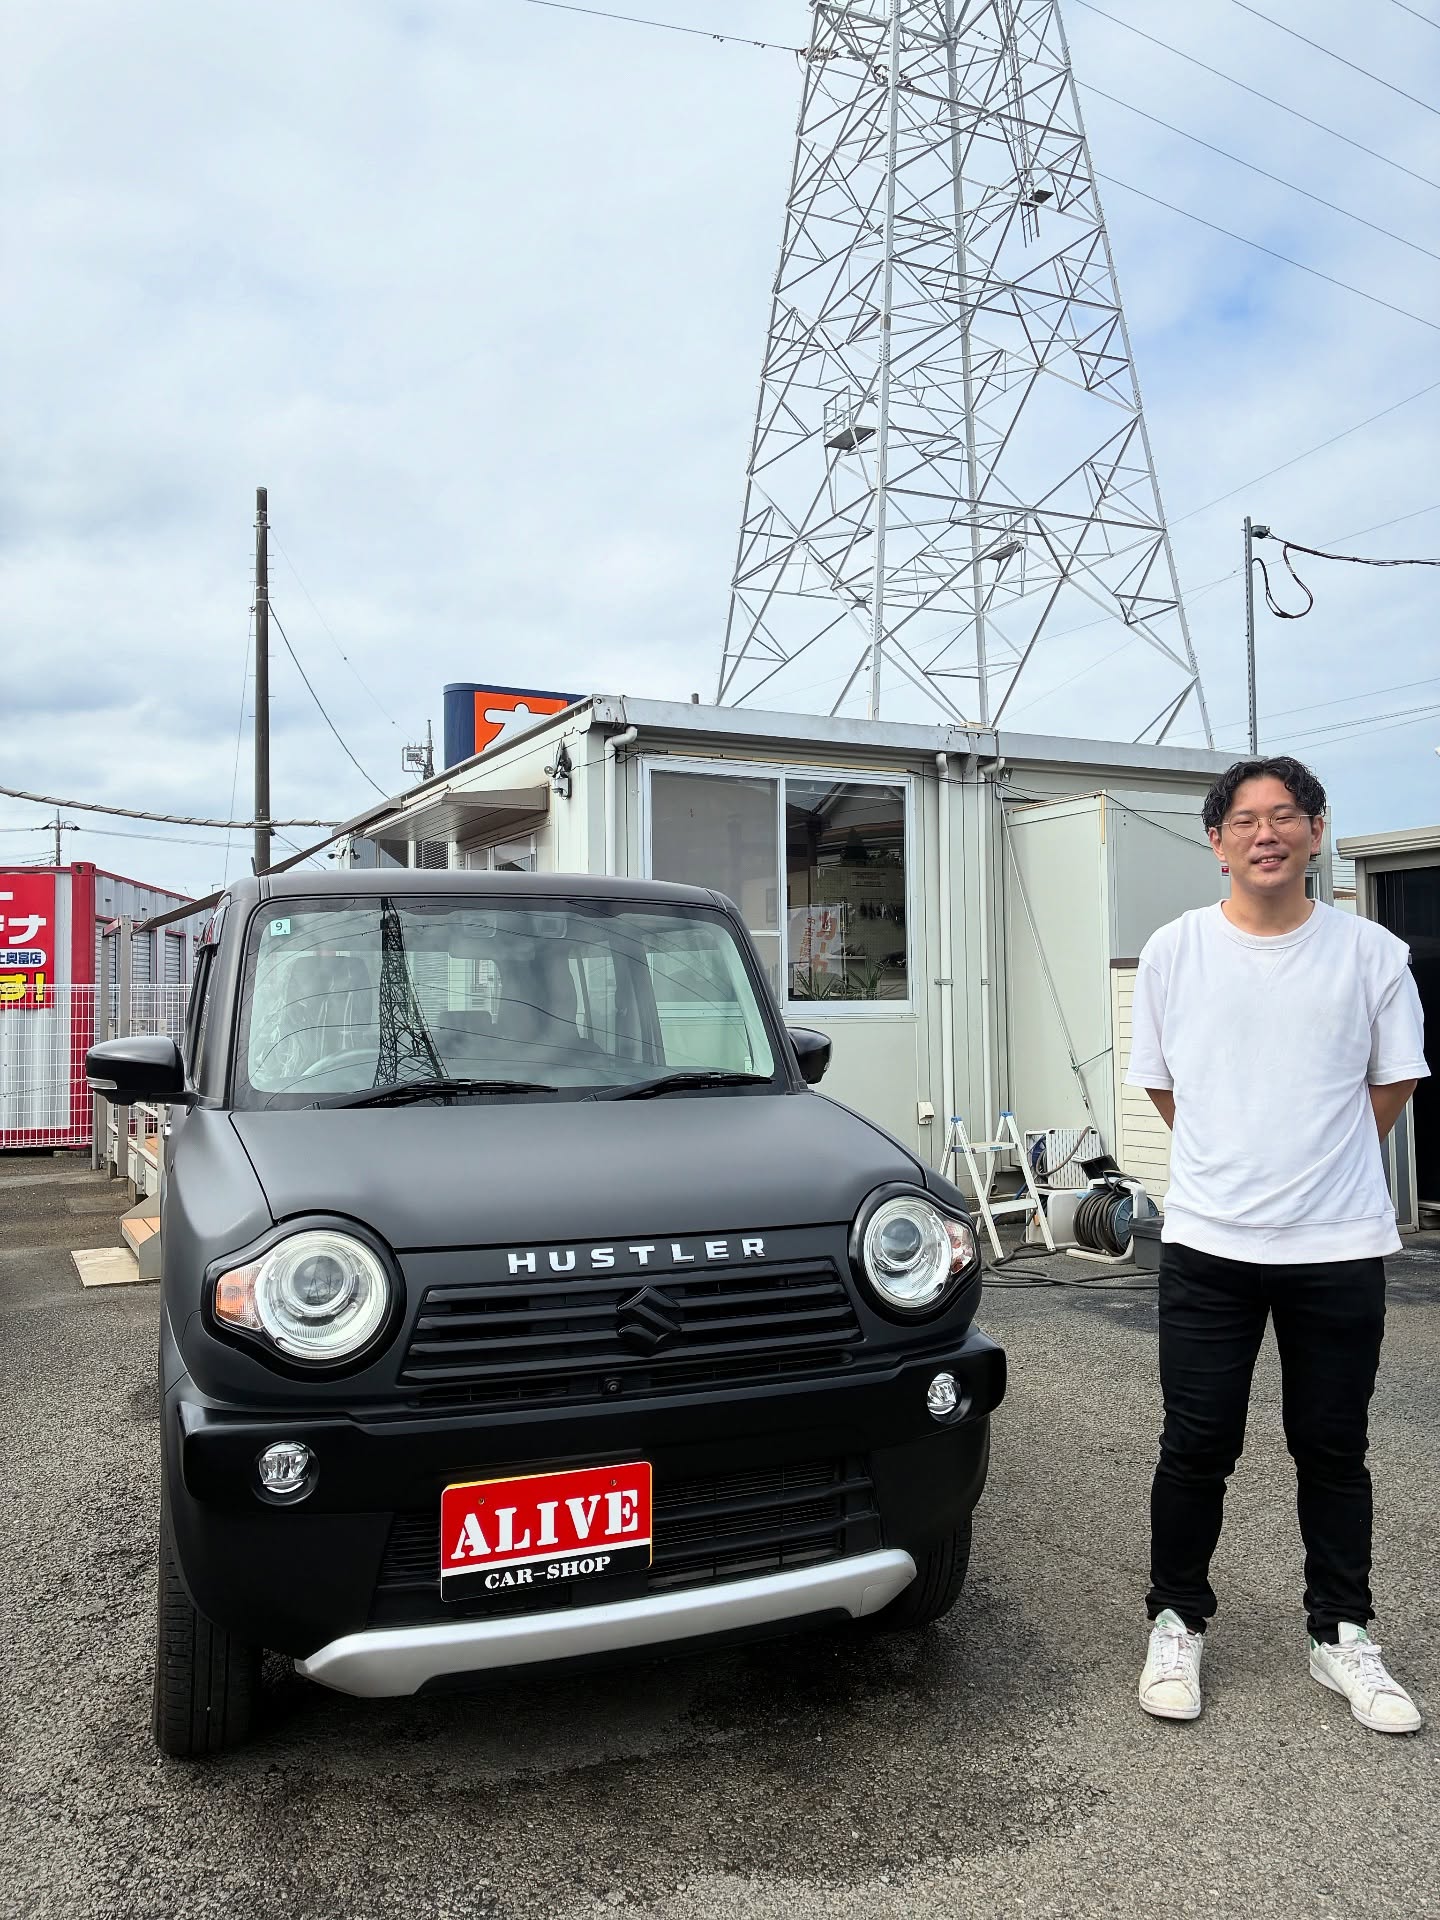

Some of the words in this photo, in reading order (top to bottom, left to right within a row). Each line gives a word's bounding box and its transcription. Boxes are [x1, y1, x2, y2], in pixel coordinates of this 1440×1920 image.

[0, 914, 47, 945] ナ
[275, 921, 283, 931] 9
[507, 1238, 766, 1274] HUSTLER
[450, 1489, 638, 1560] ALIVE
[484, 1555, 611, 1590] CAR-SHOP
